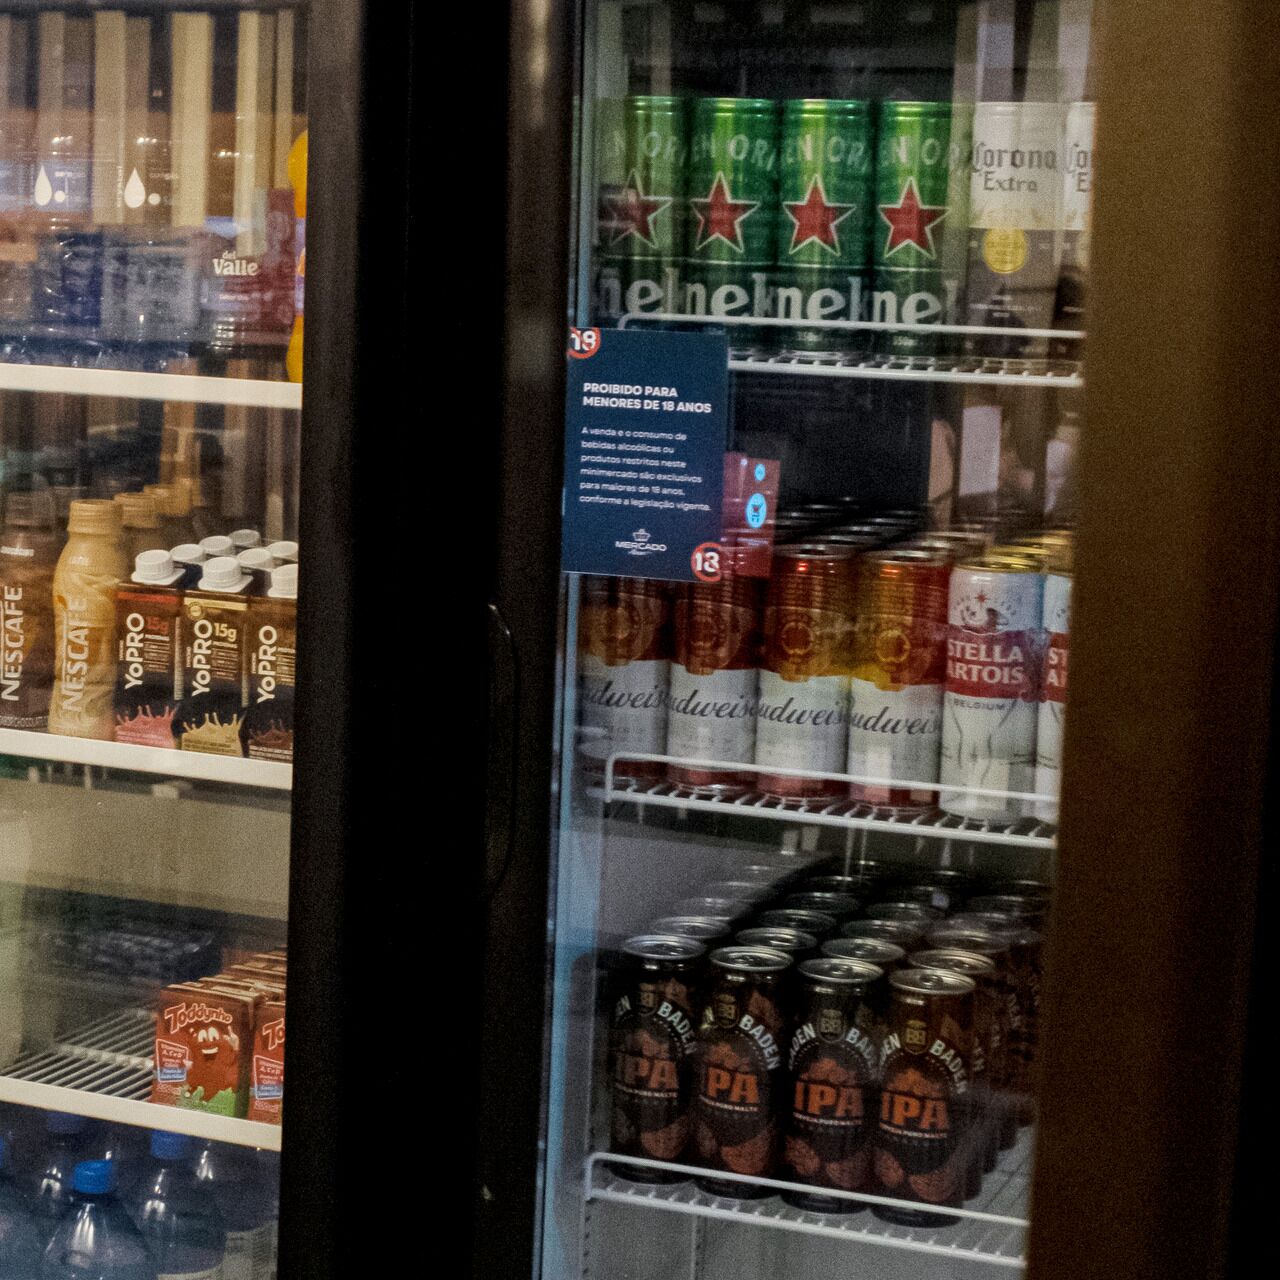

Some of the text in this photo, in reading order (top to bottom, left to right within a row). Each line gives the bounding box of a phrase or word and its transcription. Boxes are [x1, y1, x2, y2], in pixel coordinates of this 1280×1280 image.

[212, 258, 262, 277] Valle
[583, 382, 679, 398] PROIBIDO PARA
[582, 396, 712, 414] MENORES DE 18 ANOS
[589, 427, 616, 437] venda
[632, 430, 674, 440] consumo
[614, 540, 668, 552] MERCADO
[213, 622, 238, 642] 15g
[124, 612, 146, 691] YoPRO
[191, 619, 214, 697] YoPRO
[256, 624, 279, 704] YoPRO
[164, 1001, 234, 1035] Toddynho
[794, 1080, 865, 1119] IPA
[879, 1090, 951, 1131] IPA
